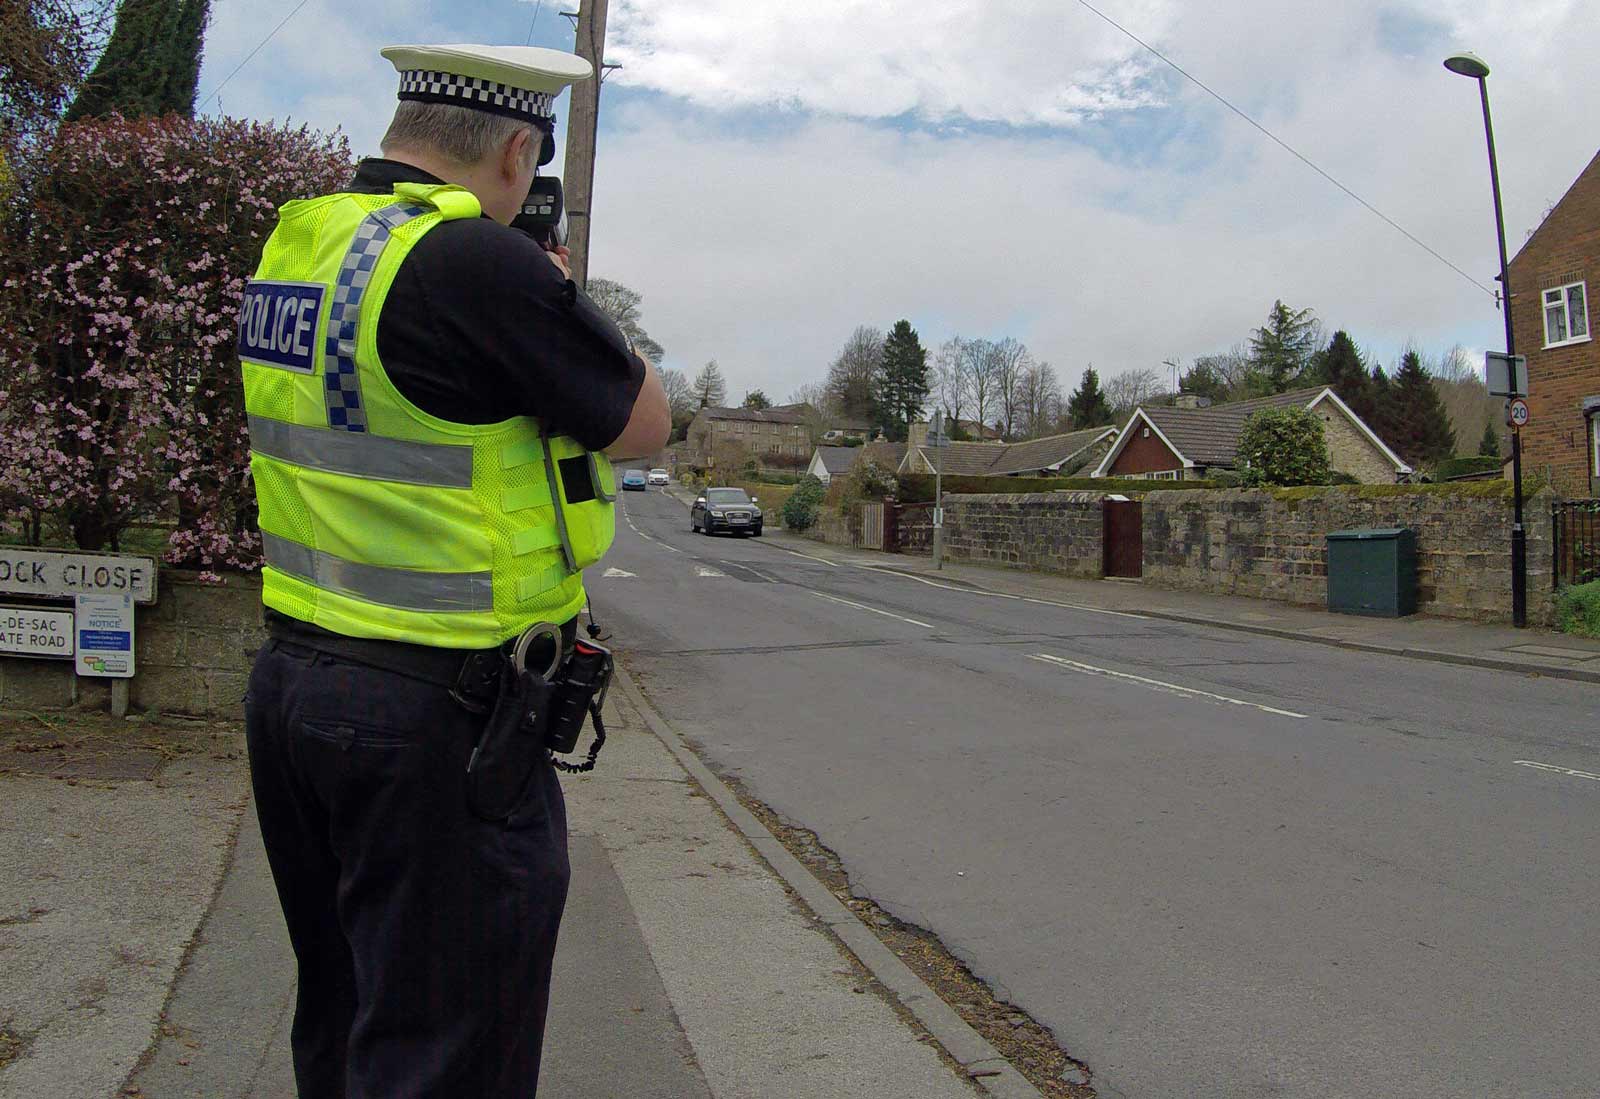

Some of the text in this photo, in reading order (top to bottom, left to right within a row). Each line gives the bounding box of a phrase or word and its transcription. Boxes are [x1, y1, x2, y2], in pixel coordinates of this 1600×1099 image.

[239, 293, 316, 357] POLICE
[1513, 407, 1527, 419] 20
[63, 565, 143, 590] CLOSE
[0, 617, 57, 632] -DE-SAC
[89, 620, 121, 629] NOTICE
[30, 634, 65, 648] ROAD
